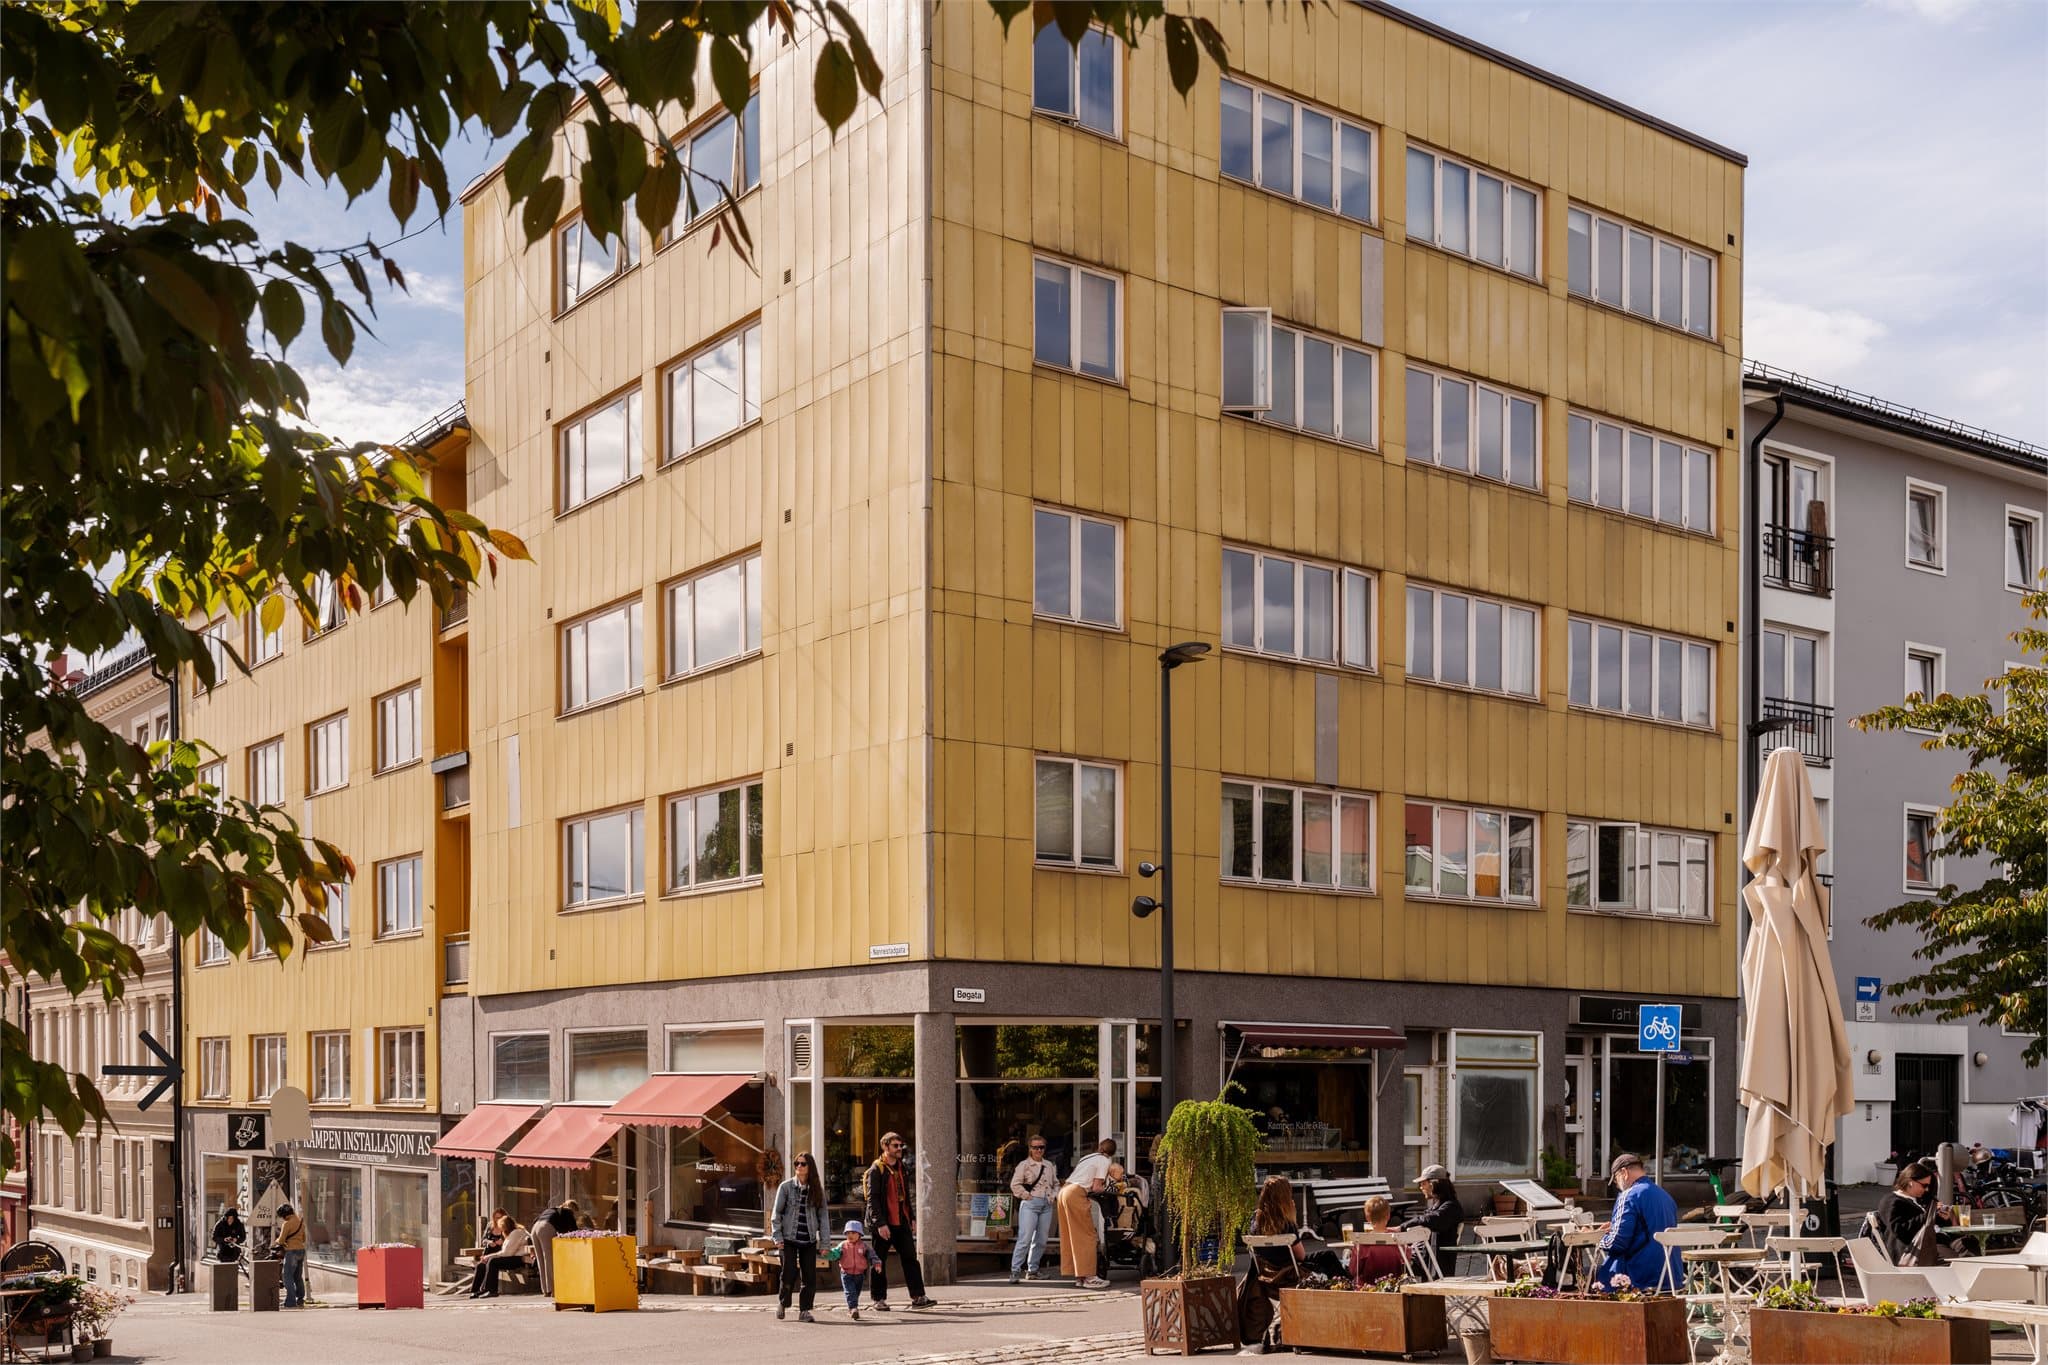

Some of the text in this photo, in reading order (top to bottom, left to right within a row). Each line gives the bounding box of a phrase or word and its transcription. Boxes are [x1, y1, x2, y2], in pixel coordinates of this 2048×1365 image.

[956, 989, 982, 1000] Bøgata
[343, 1131, 415, 1158] INSTALLASJON
[417, 1135, 431, 1156] AS
